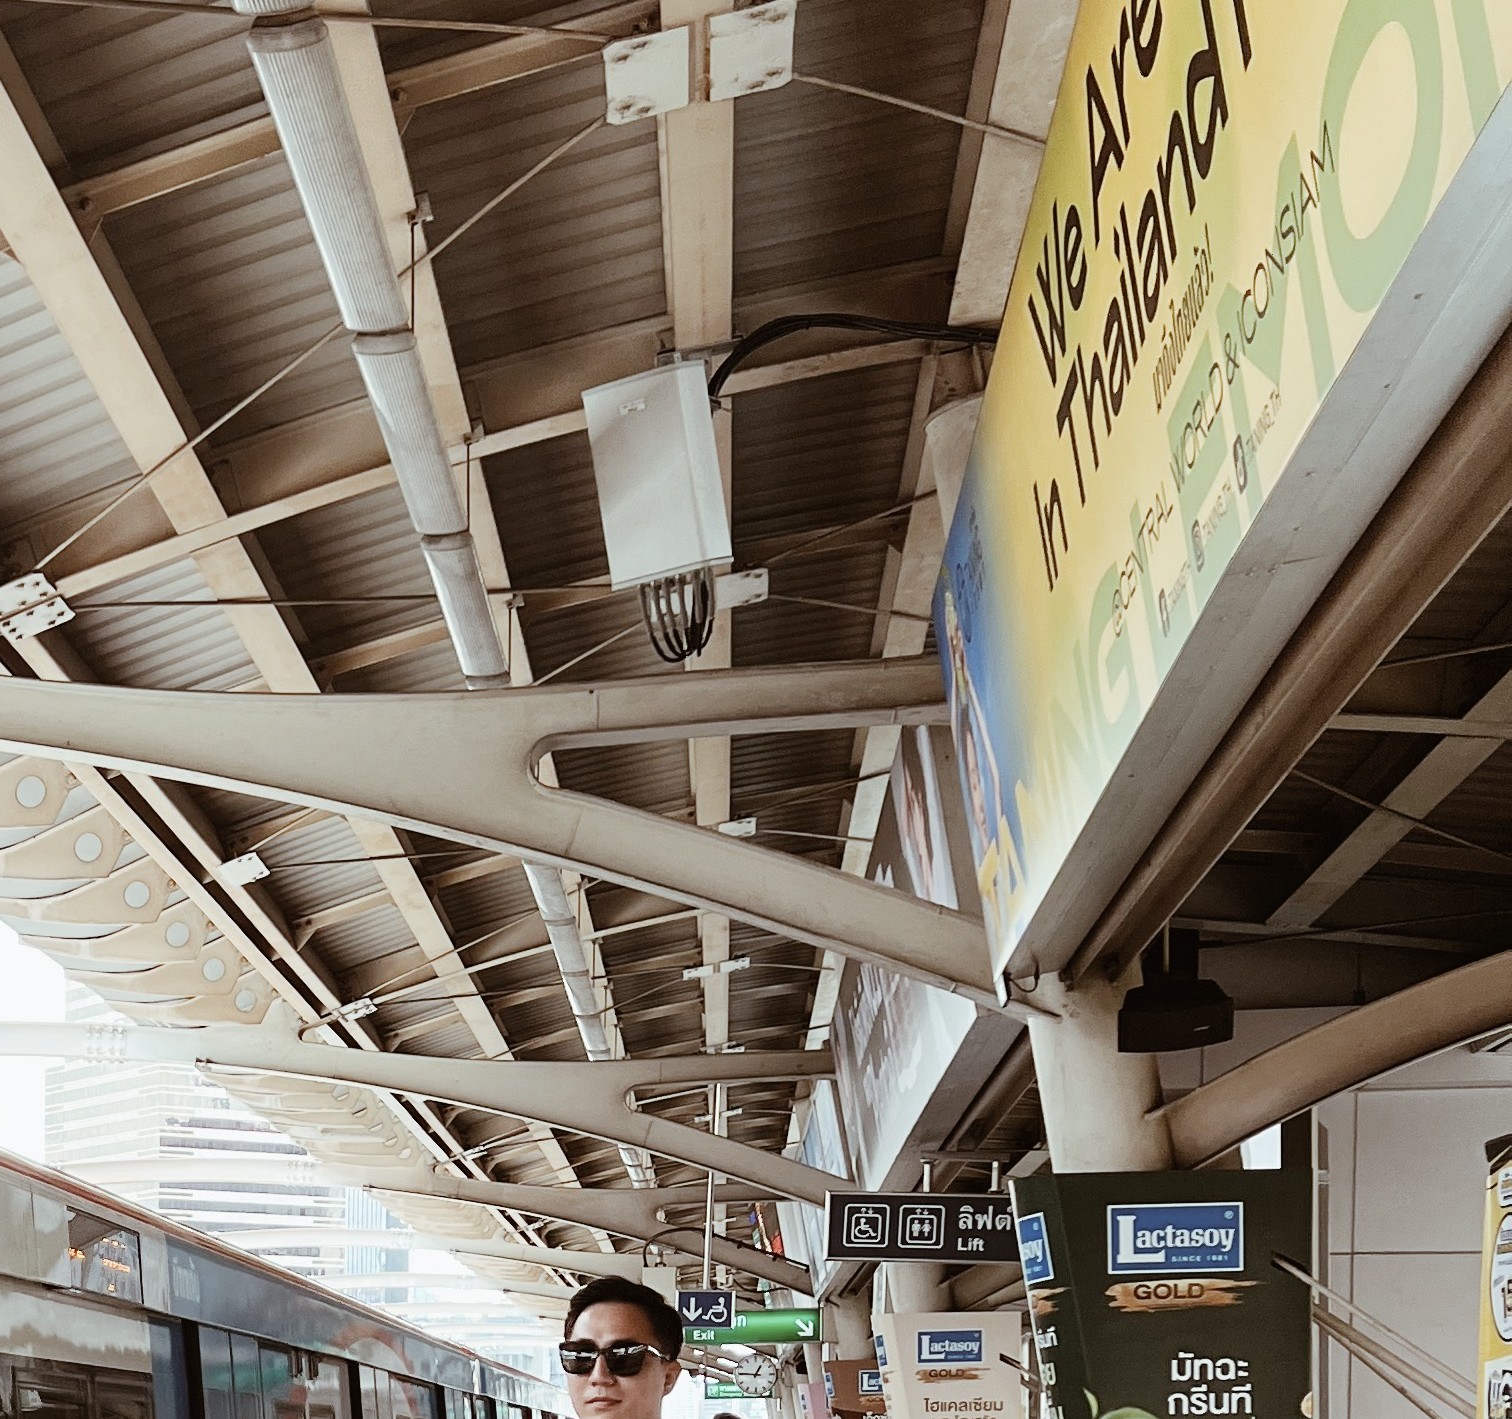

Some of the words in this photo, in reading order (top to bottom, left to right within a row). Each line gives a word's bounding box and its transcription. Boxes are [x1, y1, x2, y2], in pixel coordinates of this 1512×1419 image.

[1027, 196, 1089, 389] We
[1085, 0, 1164, 251] Are
[1032, 480, 1069, 593] In
[1055, 0, 1230, 510] Thailand
[1169, 361, 1225, 495] WORLD
[1223, 332, 1241, 386] &
[1236, 119, 1336, 358] ICONSIAM
[956, 1237, 986, 1252] Lift
[1116, 1214, 1236, 1264] Lactasoy
[1133, 1282, 1205, 1300] GOLD
[692, 1329, 716, 1342] Exit
[920, 1334, 980, 1360] Lactasoy
[928, 1368, 966, 1379] GOLD
[1167, 1383, 1253, 1415] กรีนที
